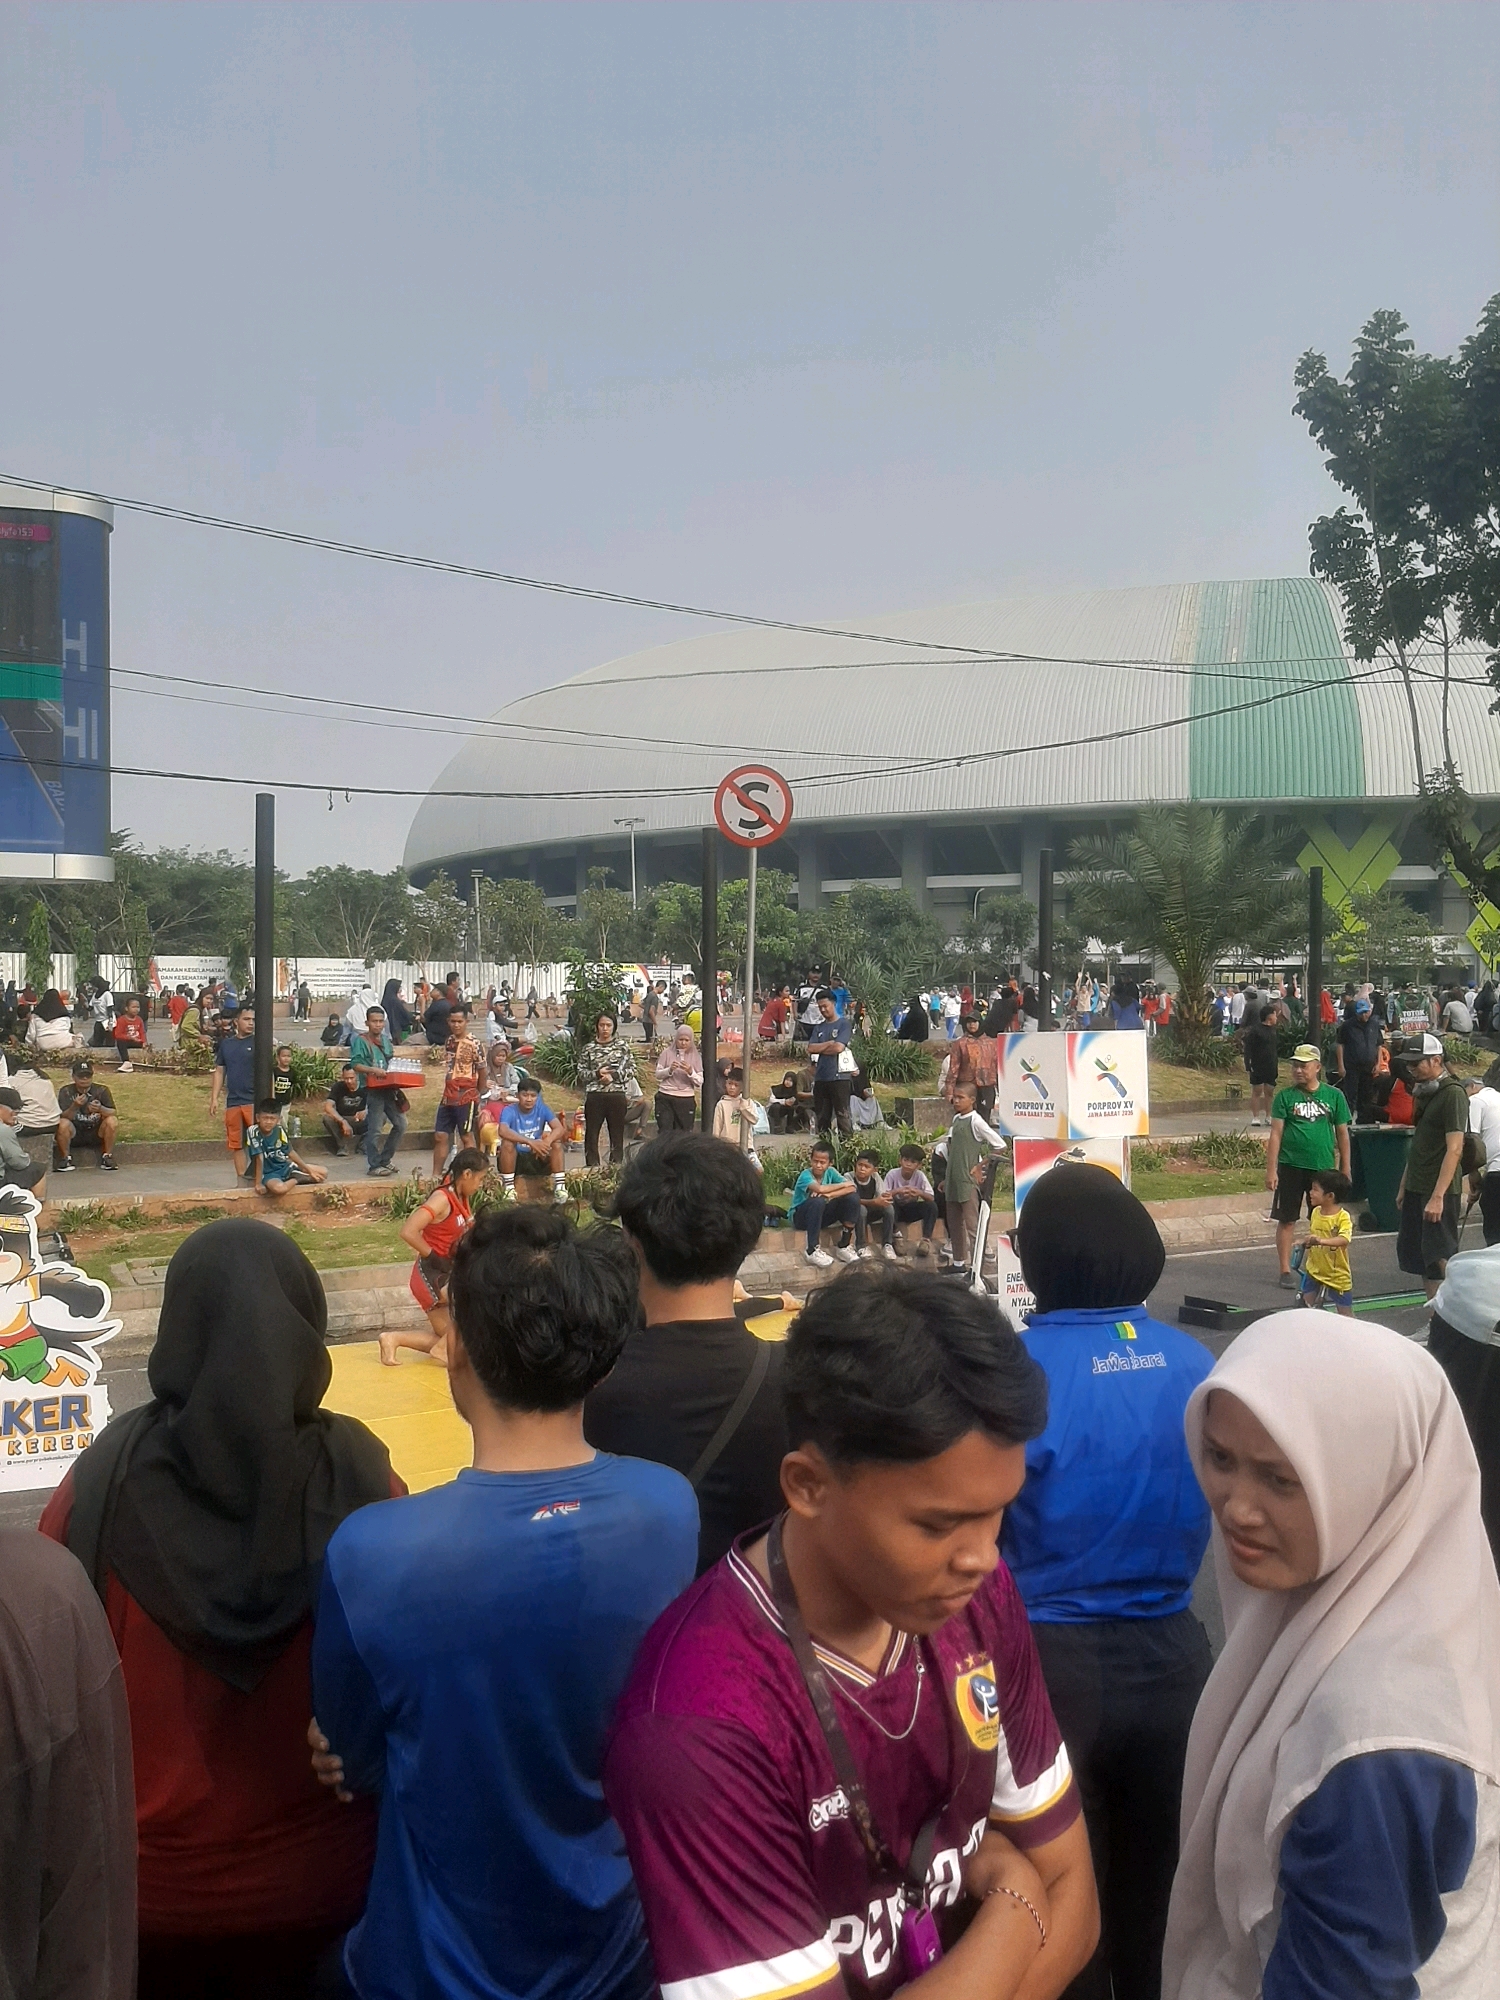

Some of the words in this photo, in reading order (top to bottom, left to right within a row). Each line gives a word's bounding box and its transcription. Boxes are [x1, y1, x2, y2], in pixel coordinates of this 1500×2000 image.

[1014, 1101, 1043, 1110] PORPROV
[1045, 1102, 1054, 1110] XV
[1087, 1101, 1121, 1110] PORPROV
[1123, 1100, 1134, 1109] XV
[0, 1395, 91, 1437] KER
[8, 1432, 94, 1456] KEREN
